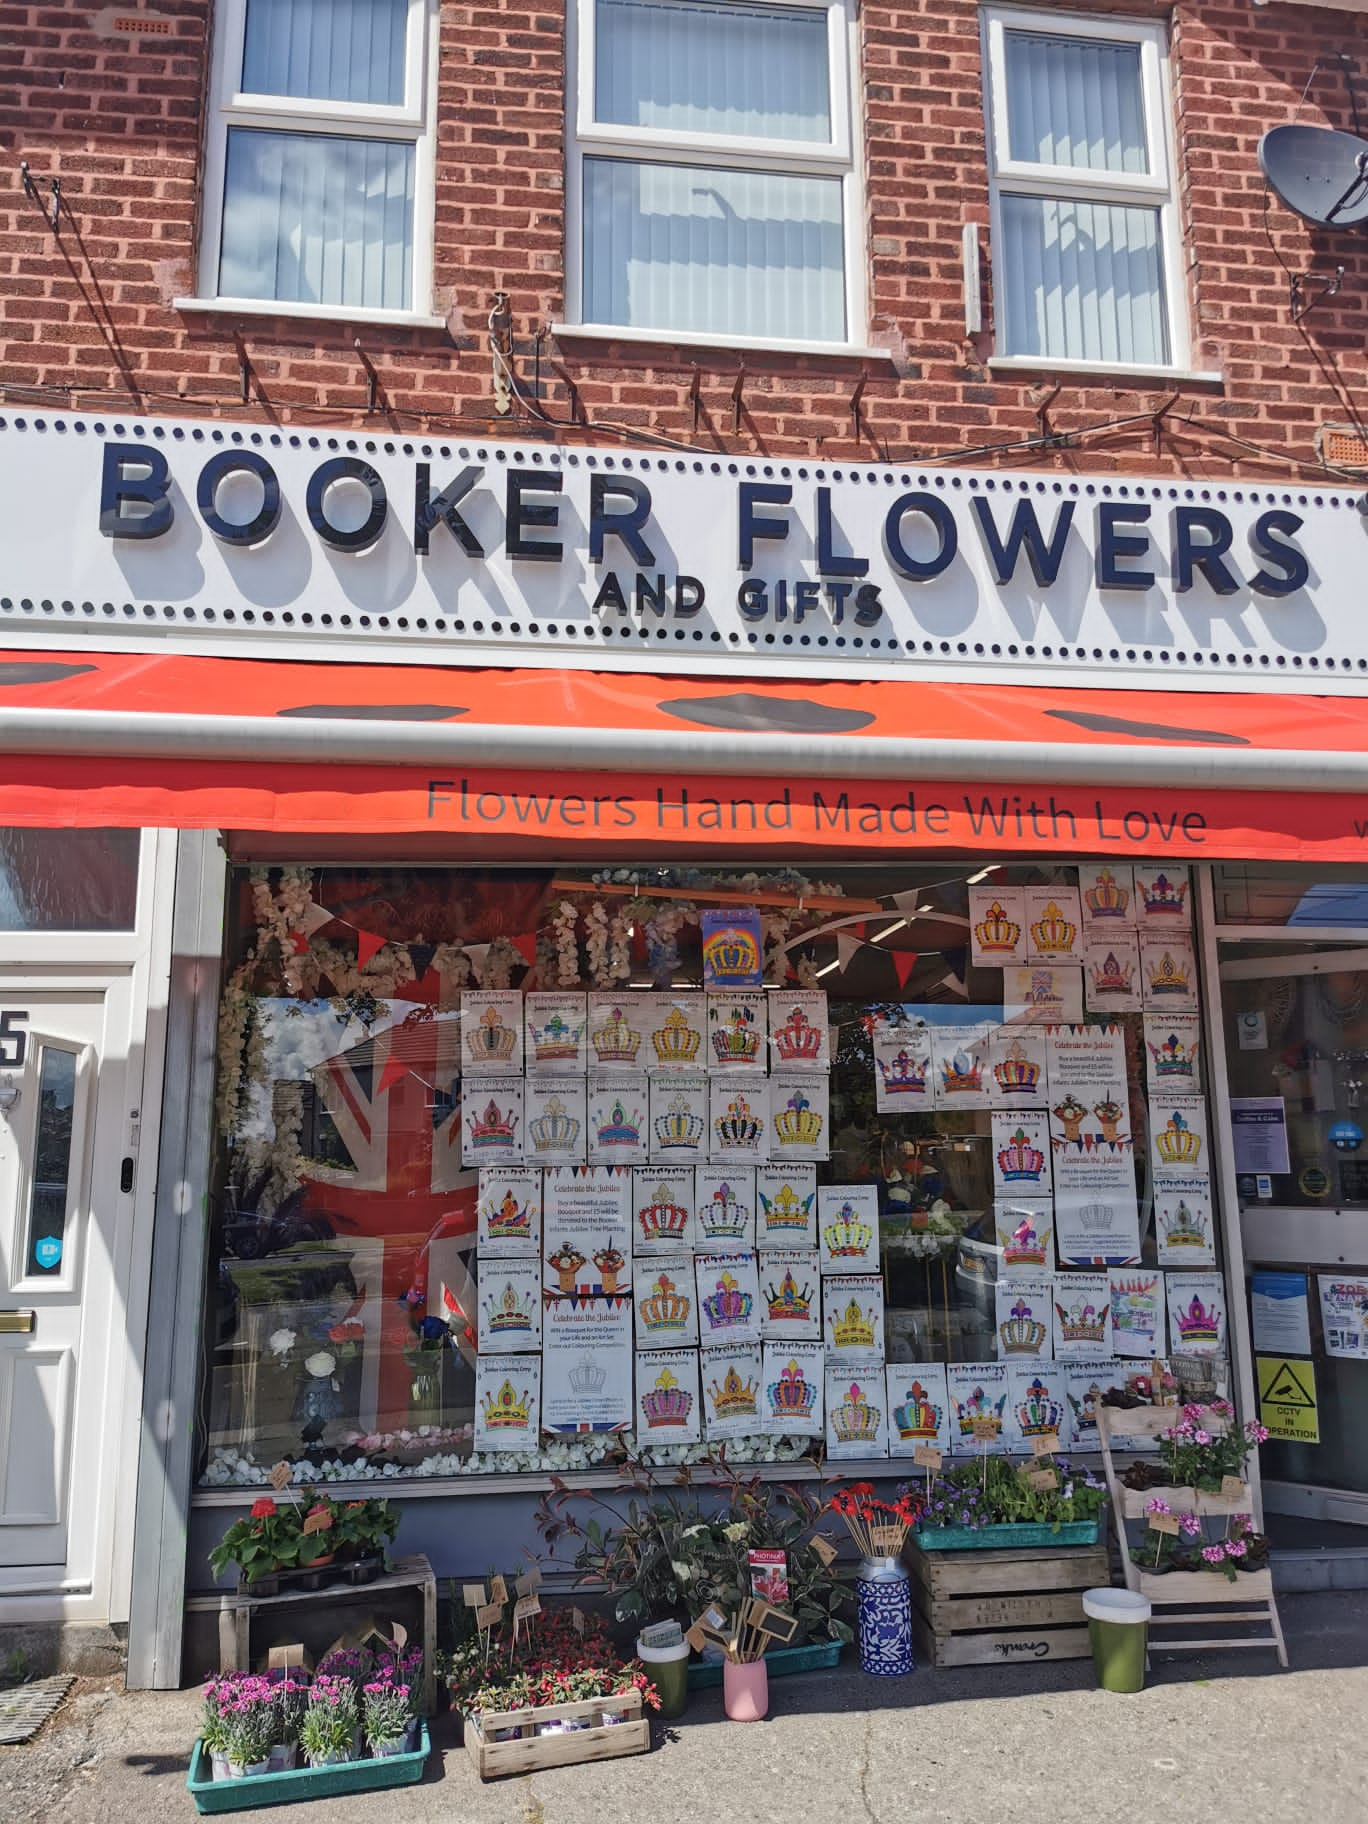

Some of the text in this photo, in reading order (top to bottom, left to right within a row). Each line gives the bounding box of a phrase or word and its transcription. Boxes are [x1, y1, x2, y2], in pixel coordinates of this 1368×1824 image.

[99, 442, 1310, 598] BOOKER FLOWERS
[592, 572, 883, 627] AND GIFTS
[427, 779, 1207, 843] Flowers Hand Made With Love
[0, 1011, 27, 1066] 5
[554, 1184, 621, 1193] Celebrate the Jubilee
[553, 1313, 621, 1322] Celebrate the Jubilee
[1277, 1407, 1300, 1416] CCTV
[1285, 1418, 1294, 1426] IN
